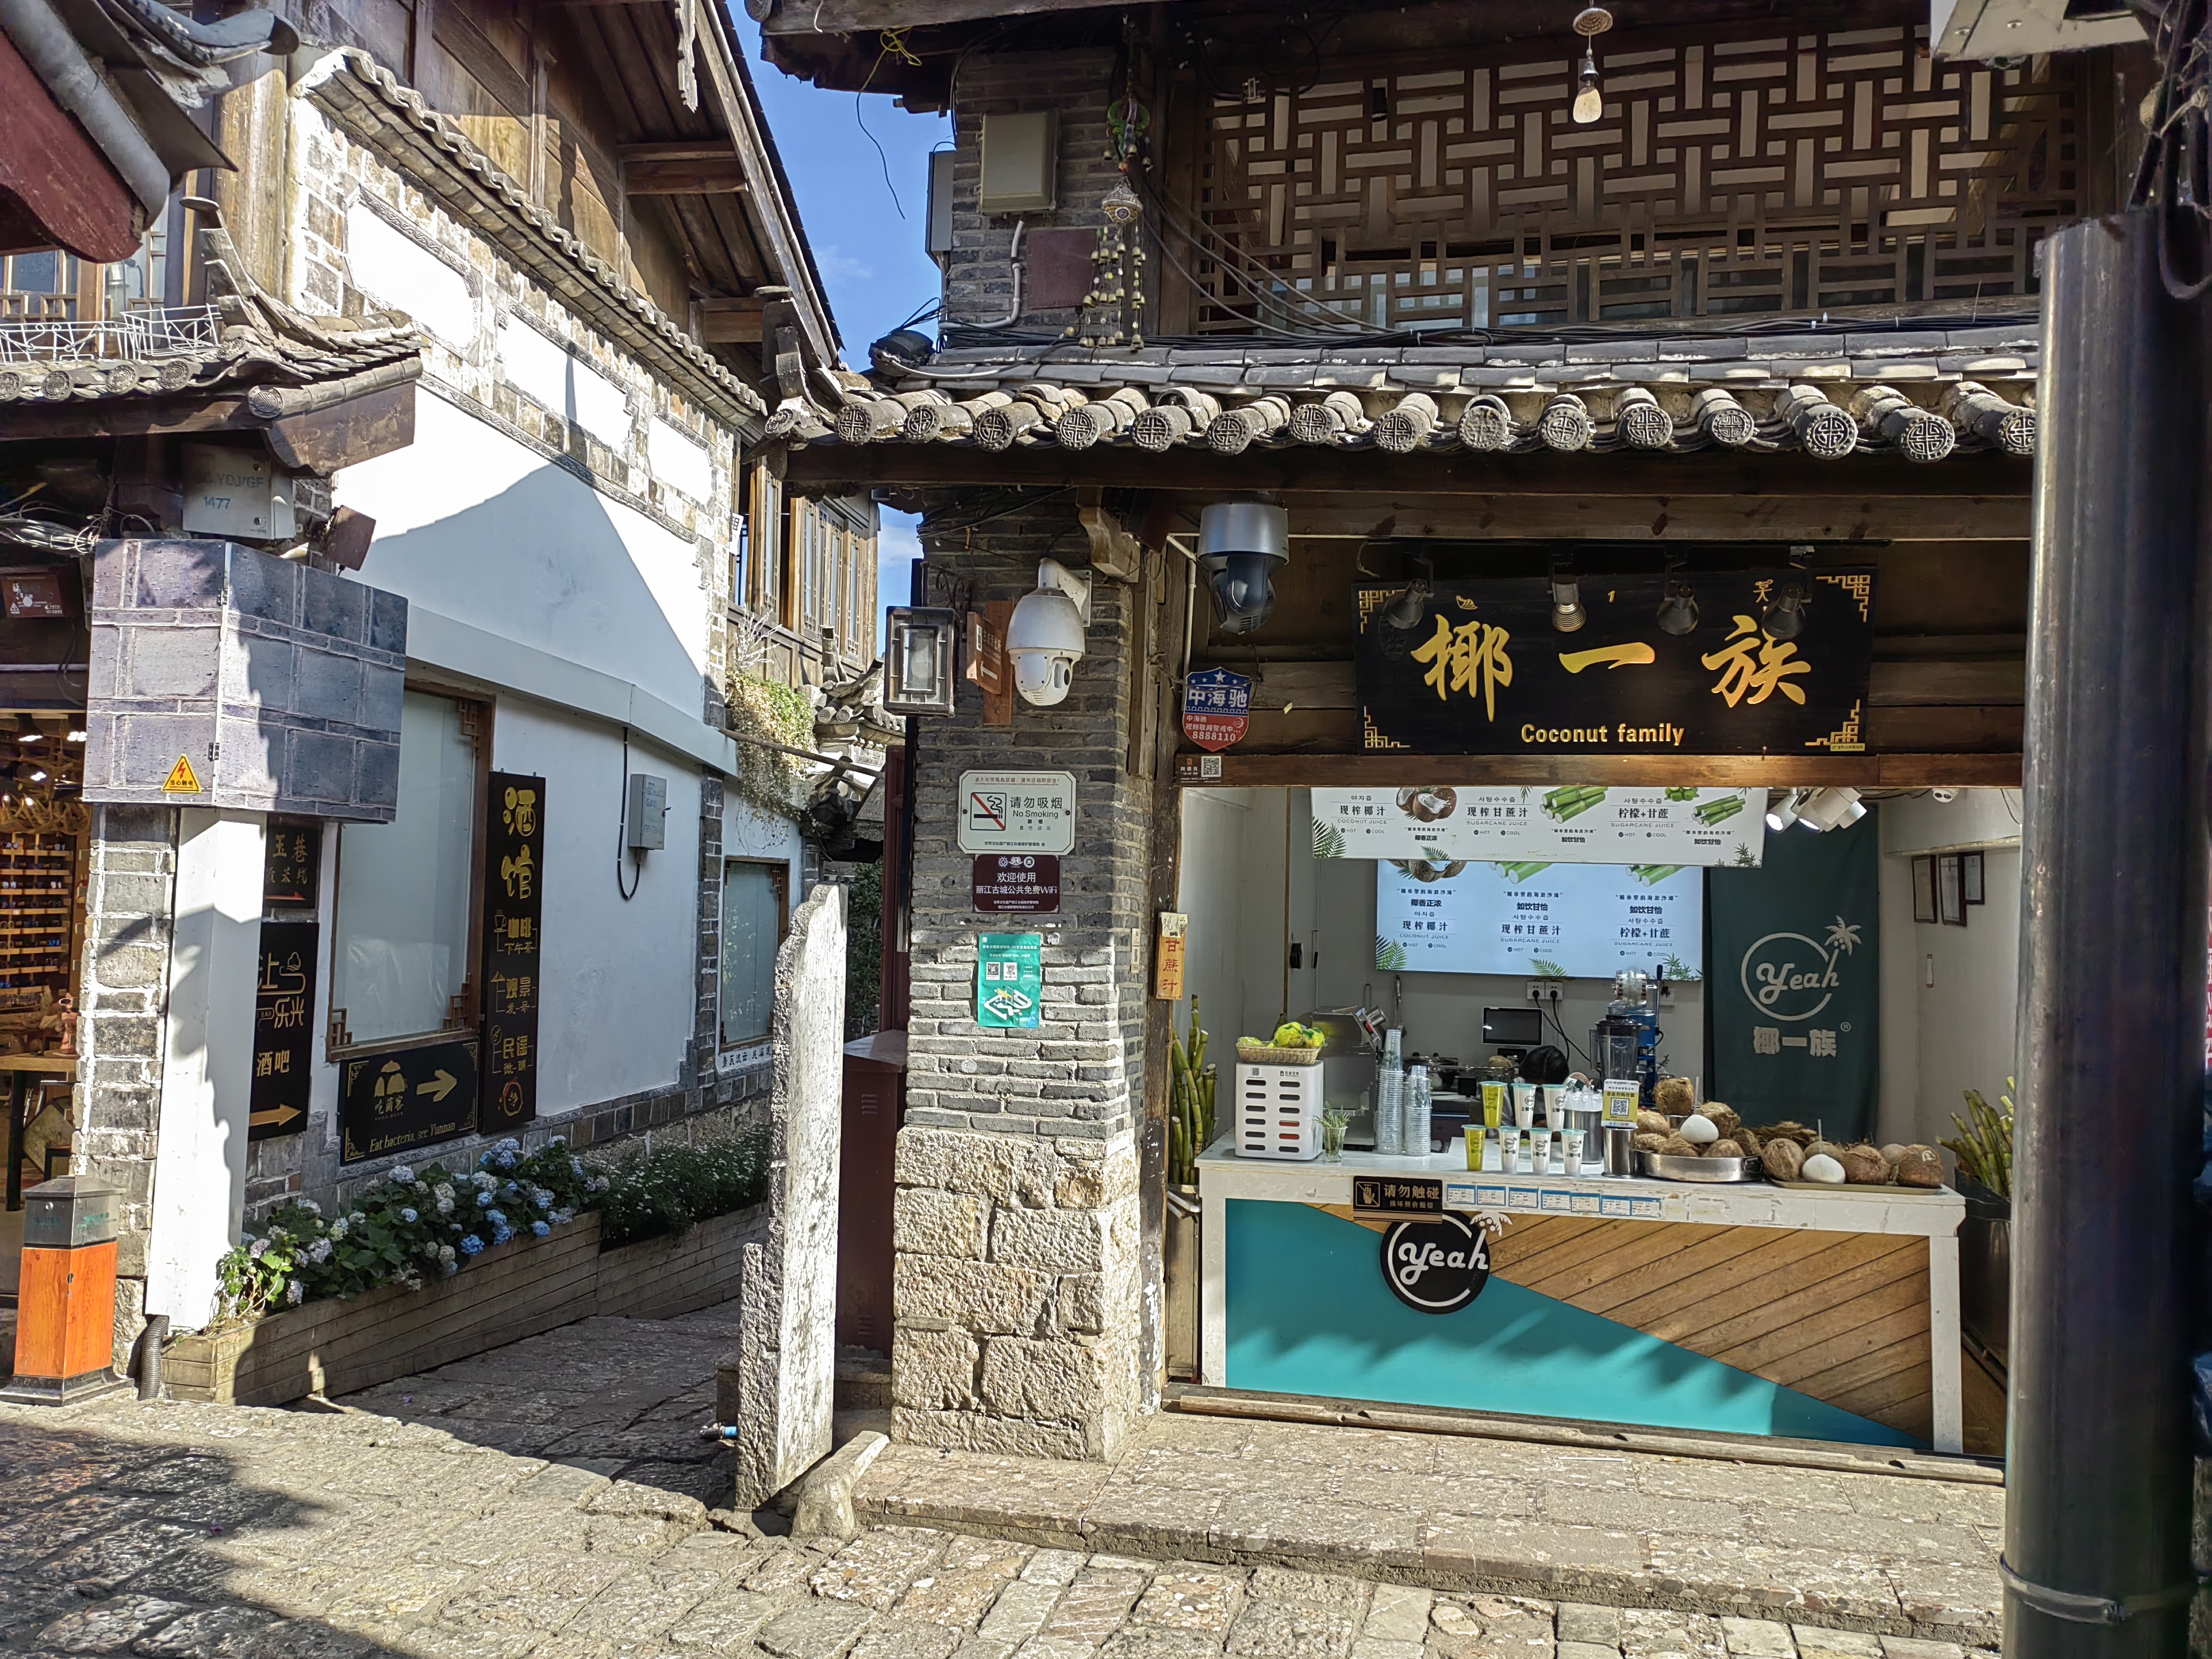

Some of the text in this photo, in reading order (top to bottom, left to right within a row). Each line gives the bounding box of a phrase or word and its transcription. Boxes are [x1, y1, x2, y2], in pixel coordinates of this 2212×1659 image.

[203, 496, 231, 509] 1477
[1411, 613, 1811, 722] 椰一族
[1188, 686, 1247, 707] 中海驰
[1192, 731, 1236, 741] 8888110
[1522, 723, 1684, 746] Coconut family
[1010, 797, 1062, 809] 请勿吸烟
[1026, 810, 1058, 819] Smoking
[1340, 805, 1386, 816] 现榨椰汁
[1467, 806, 1529, 818] 现榨甘蔗汁
[1618, 808, 1669, 819] 柠檬+甘蔗
[997, 872, 1036, 883] 欢迎使用
[976, 885, 1057, 894] 丽江古城公共免费WiFi
[1411, 899, 1442, 907] 椰香正浓
[1516, 902, 1548, 911] 如饮甘怡
[1629, 906, 1663, 914] 如饮甘怡
[508, 917, 531, 938] 咖啡
[1402, 921, 1448, 931] 现榨椰汁
[1502, 924, 1561, 936] 现榨甘蔗汁
[1620, 927, 1670, 939] 柠檬+甘蔗
[504, 942, 532, 955] 下午茶
[1163, 939, 1180, 992] 甘蔗汁
[1756, 949, 1839, 1004] Yeah
[506, 976, 531, 999] 观景
[506, 1001, 530, 1014] 发呆
[503, 1035, 528, 1058] 民谣
[1754, 1026, 1837, 1057] 椰一族
[257, 1049, 290, 1077] 酒吧
[369, 1138, 383, 1152] Eat
[417, 1129, 428, 1139] see
[430, 1122, 456, 1136] Yunnan
[1384, 1184, 1440, 1199] 请勿触碰
[1398, 1229, 1488, 1285] Yeah
